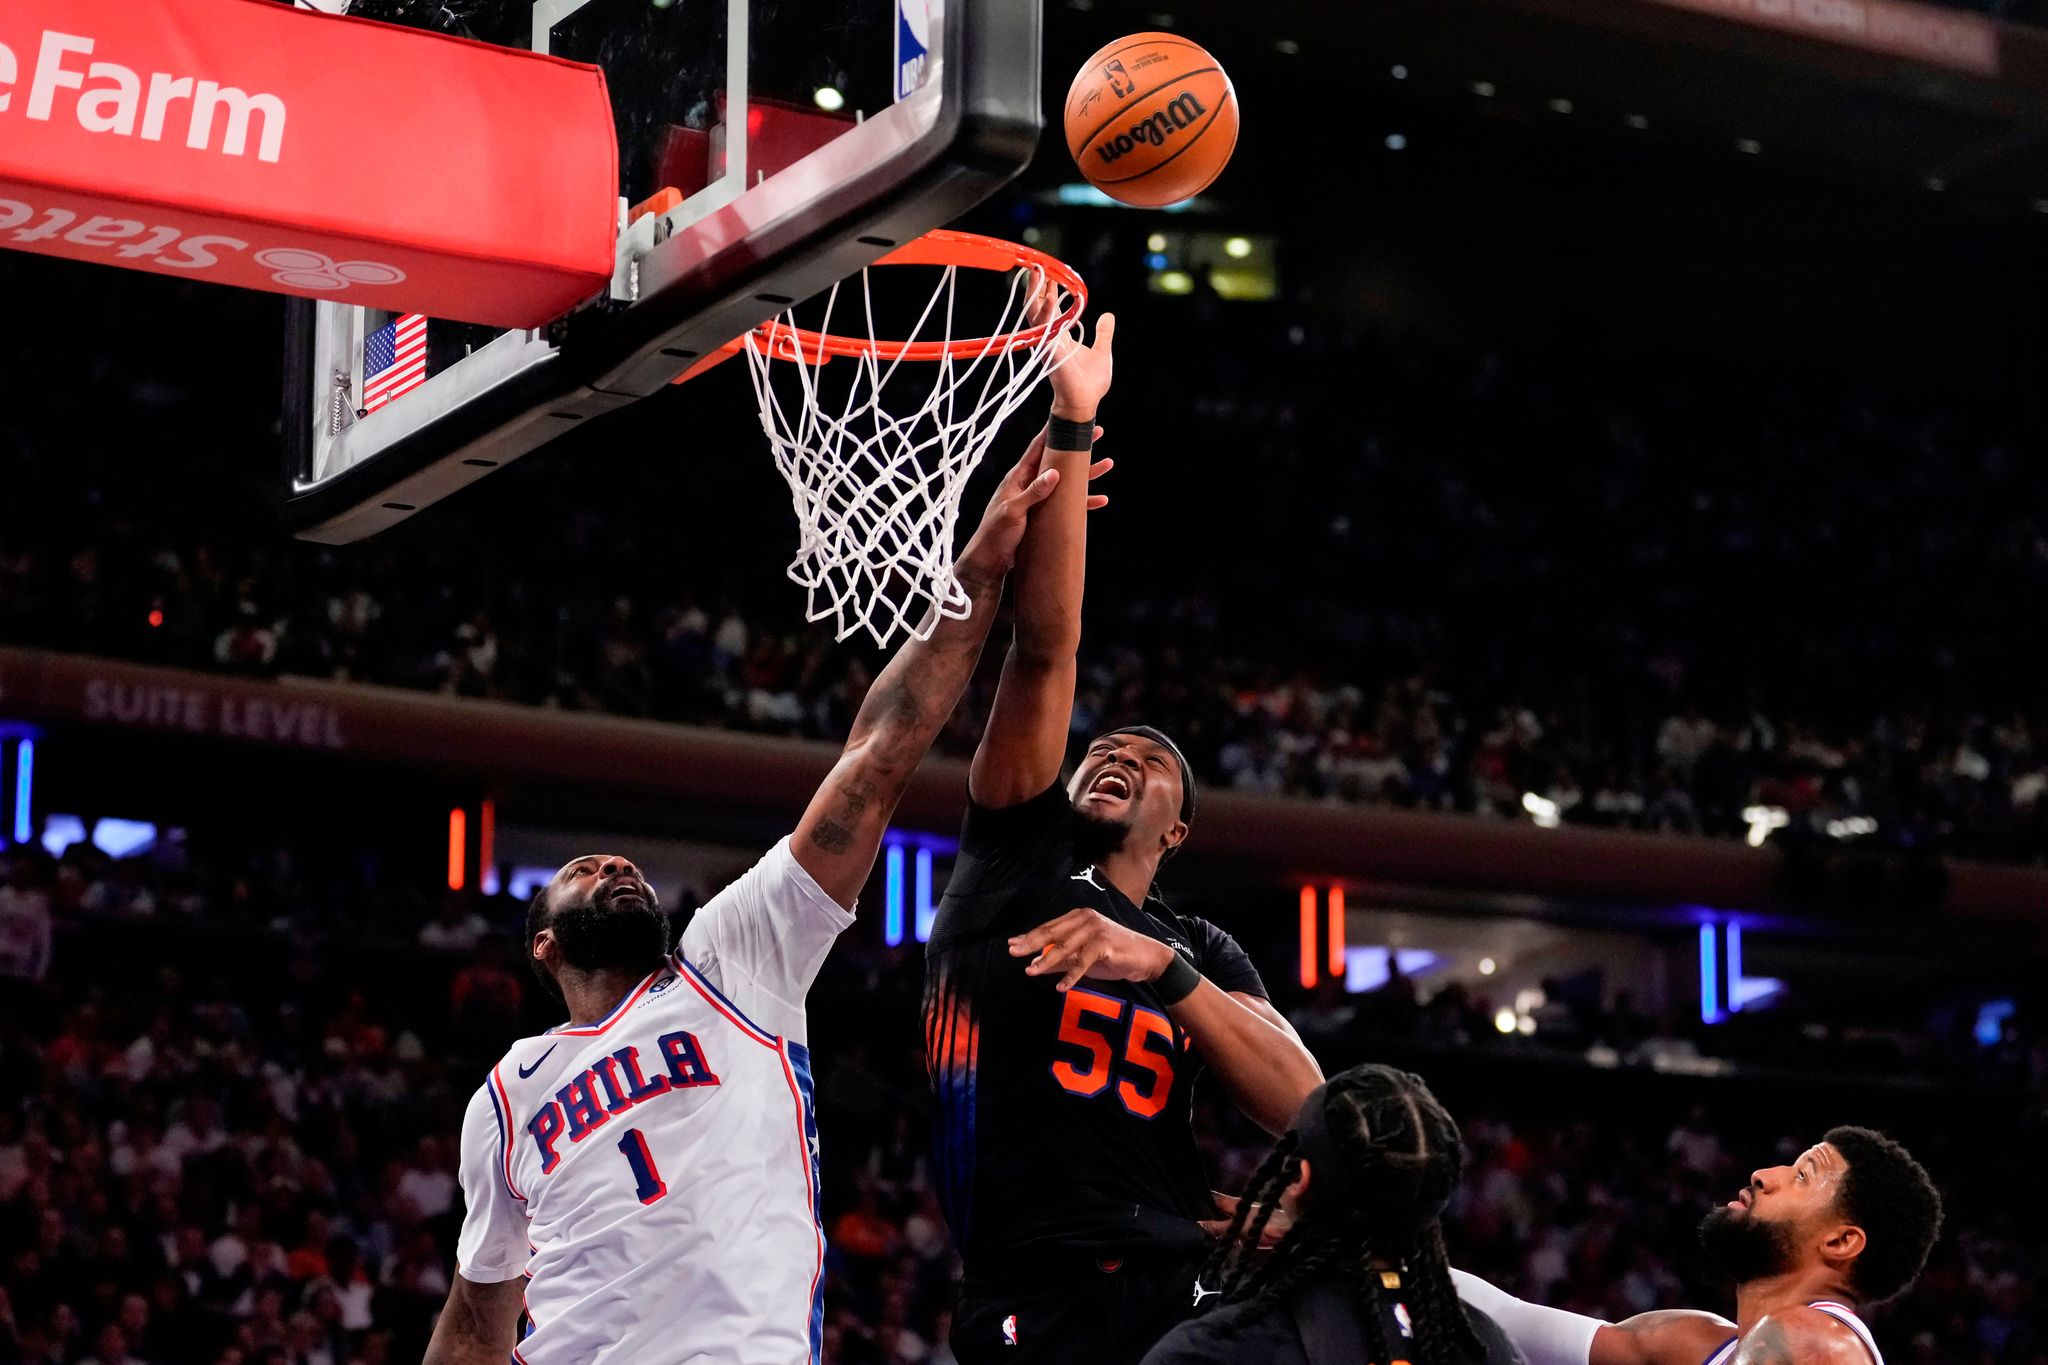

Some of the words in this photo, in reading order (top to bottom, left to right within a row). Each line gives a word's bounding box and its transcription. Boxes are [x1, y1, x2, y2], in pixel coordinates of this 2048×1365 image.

[26, 30, 286, 163] Farm
[1096, 90, 1207, 163] Wilson
[84, 679, 208, 731] SUITE
[222, 696, 344, 748] LEVEL
[527, 1030, 721, 1175] PHILA
[1050, 986, 1176, 1121] 55
[617, 1128, 668, 1205] 1
